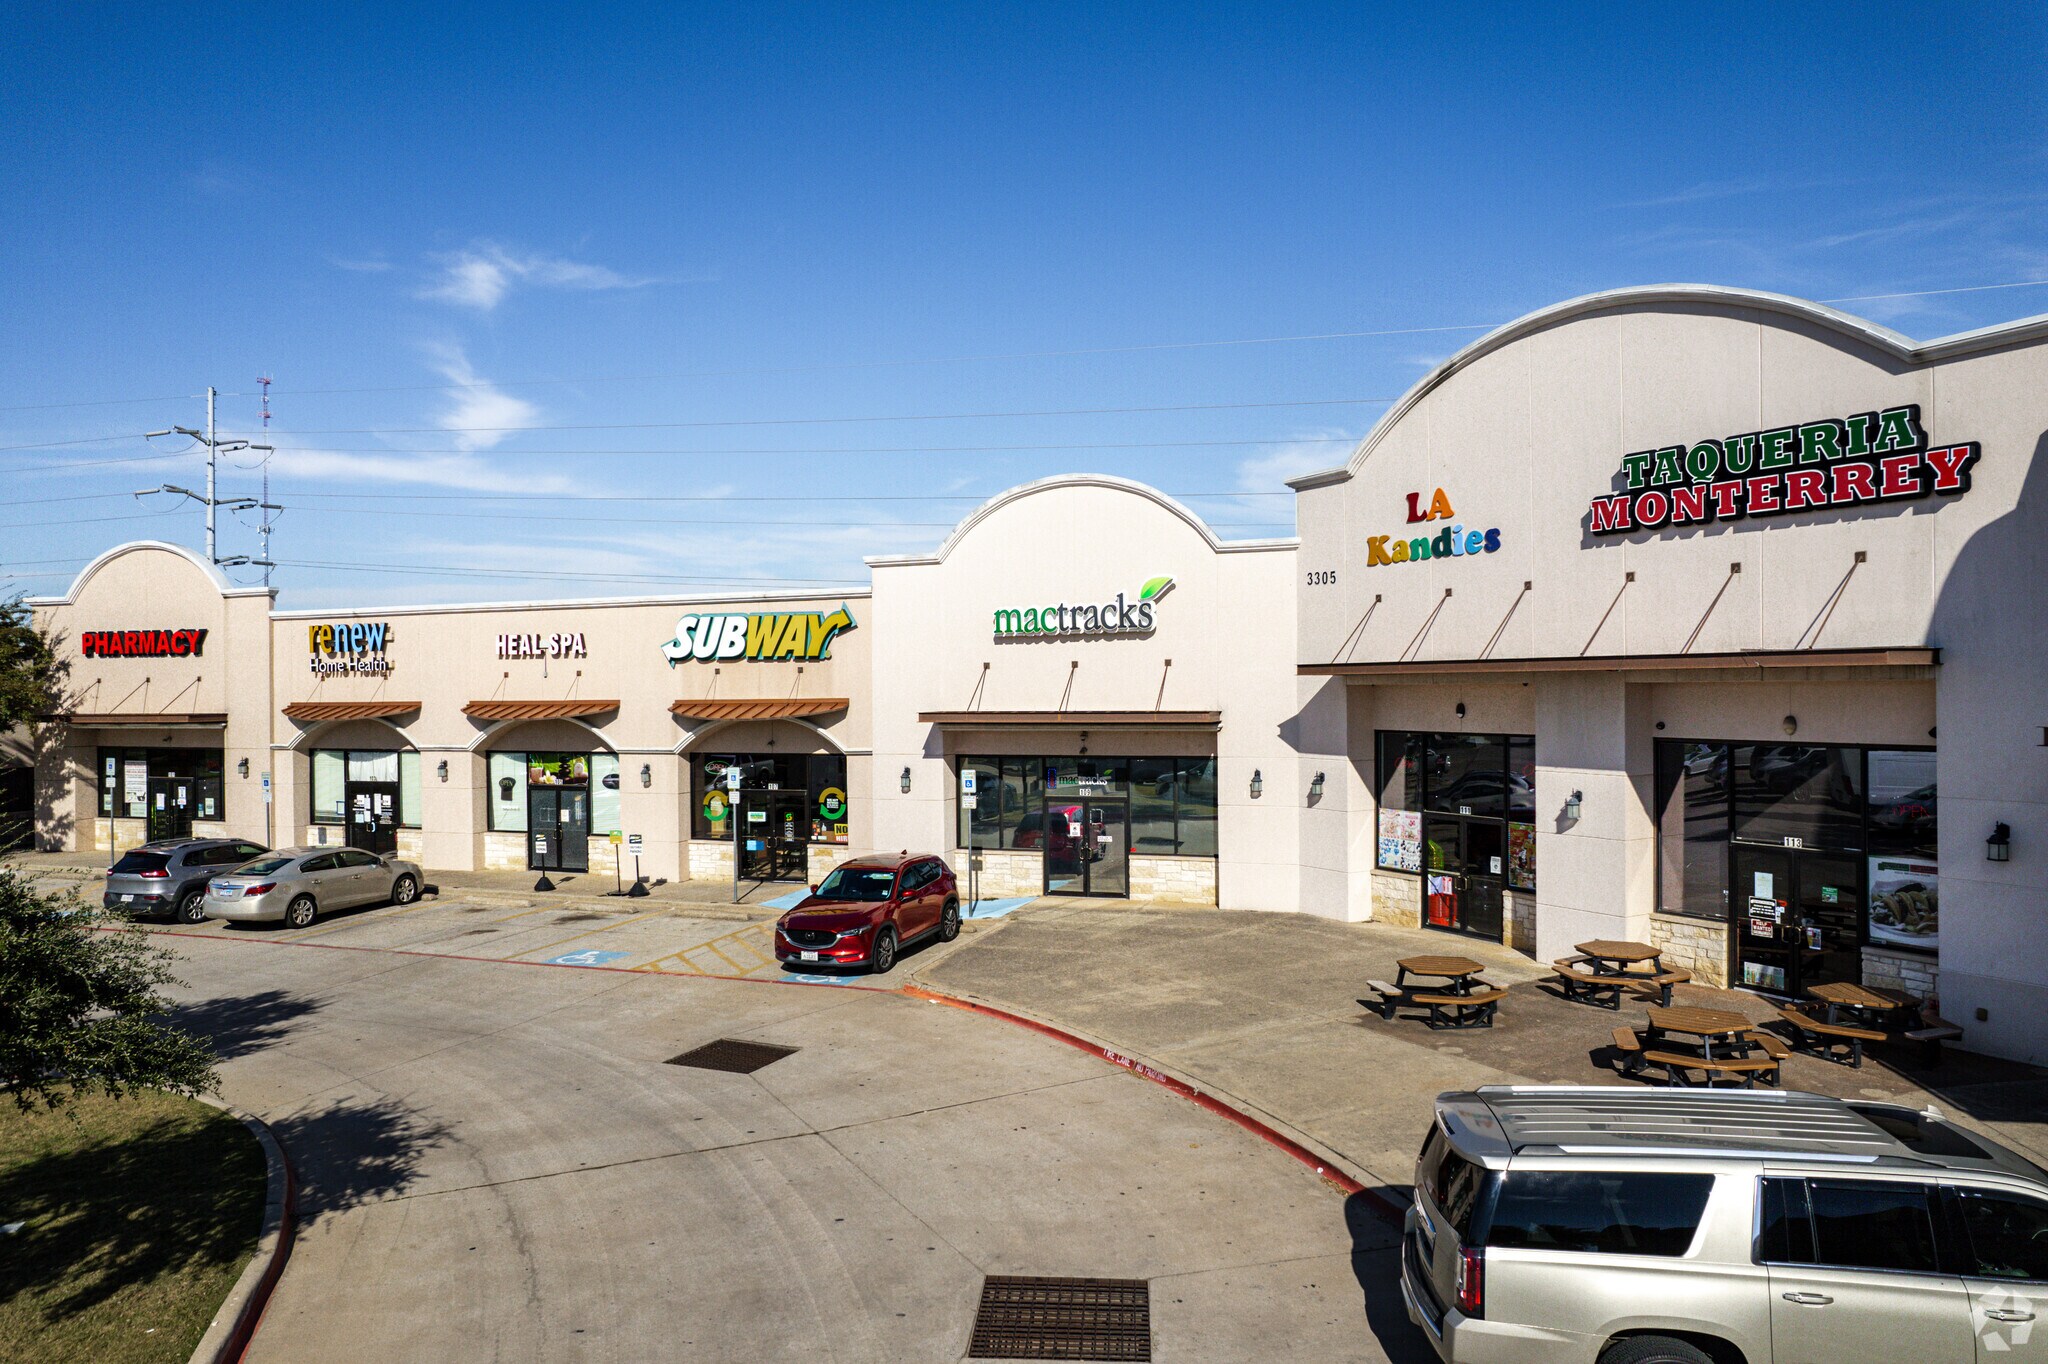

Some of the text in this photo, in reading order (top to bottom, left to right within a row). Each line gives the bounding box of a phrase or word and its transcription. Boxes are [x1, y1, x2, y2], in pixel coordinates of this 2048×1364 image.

[1621, 407, 1918, 490] TAQUERIA
[1590, 446, 1971, 532] MONTERREY
[1405, 487, 1455, 524] LA
[1366, 523, 1501, 567] Kandies
[1306, 570, 1337, 586] 3305
[993, 592, 1154, 634] mactracks
[82, 630, 203, 656] PHARMACY
[308, 622, 386, 654] renew
[495, 633, 543, 655] HEAL
[661, 606, 854, 665] SUBWAY
[309, 657, 387, 673] Home Health
[1459, 805, 1472, 815] 111
[1785, 837, 1802, 848] 113
[1116, 1054, 1131, 1068] LANE
